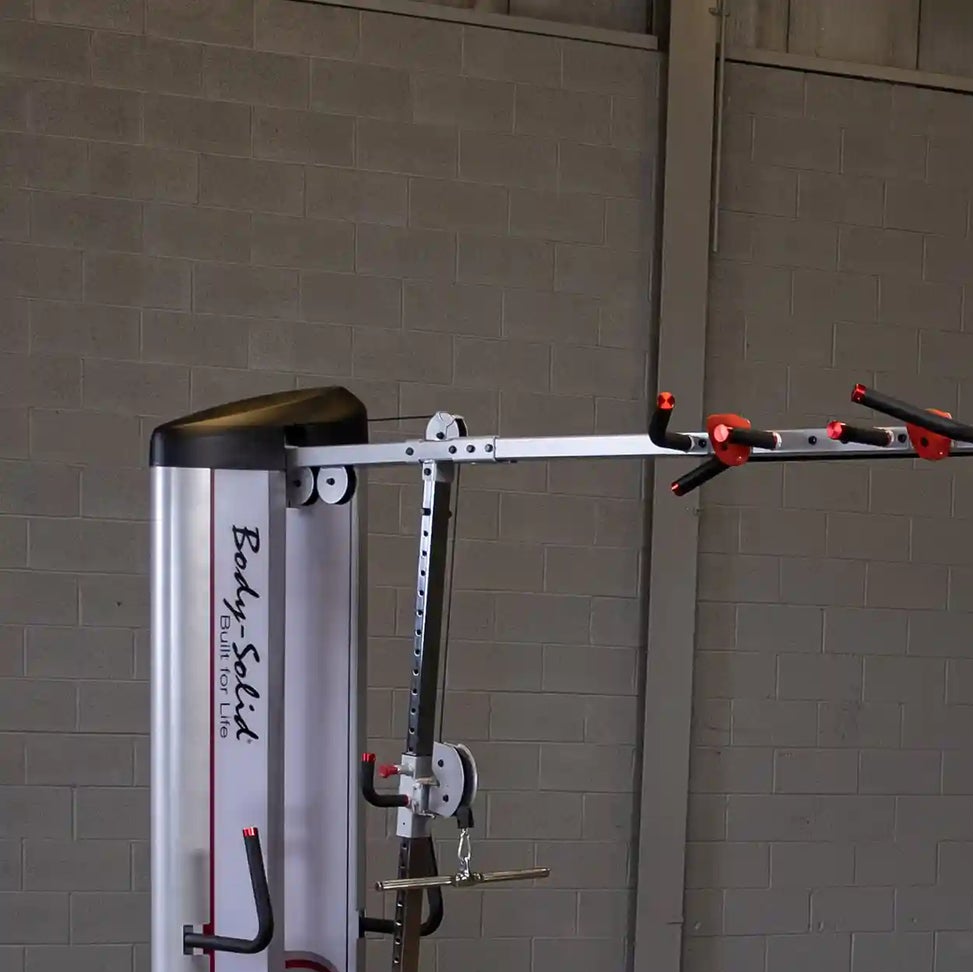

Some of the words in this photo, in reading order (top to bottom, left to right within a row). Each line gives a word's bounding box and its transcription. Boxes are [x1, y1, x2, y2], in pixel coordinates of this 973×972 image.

[220, 615, 231, 659] Built
[220, 667, 230, 696] for
[220, 702, 231, 739] Life
